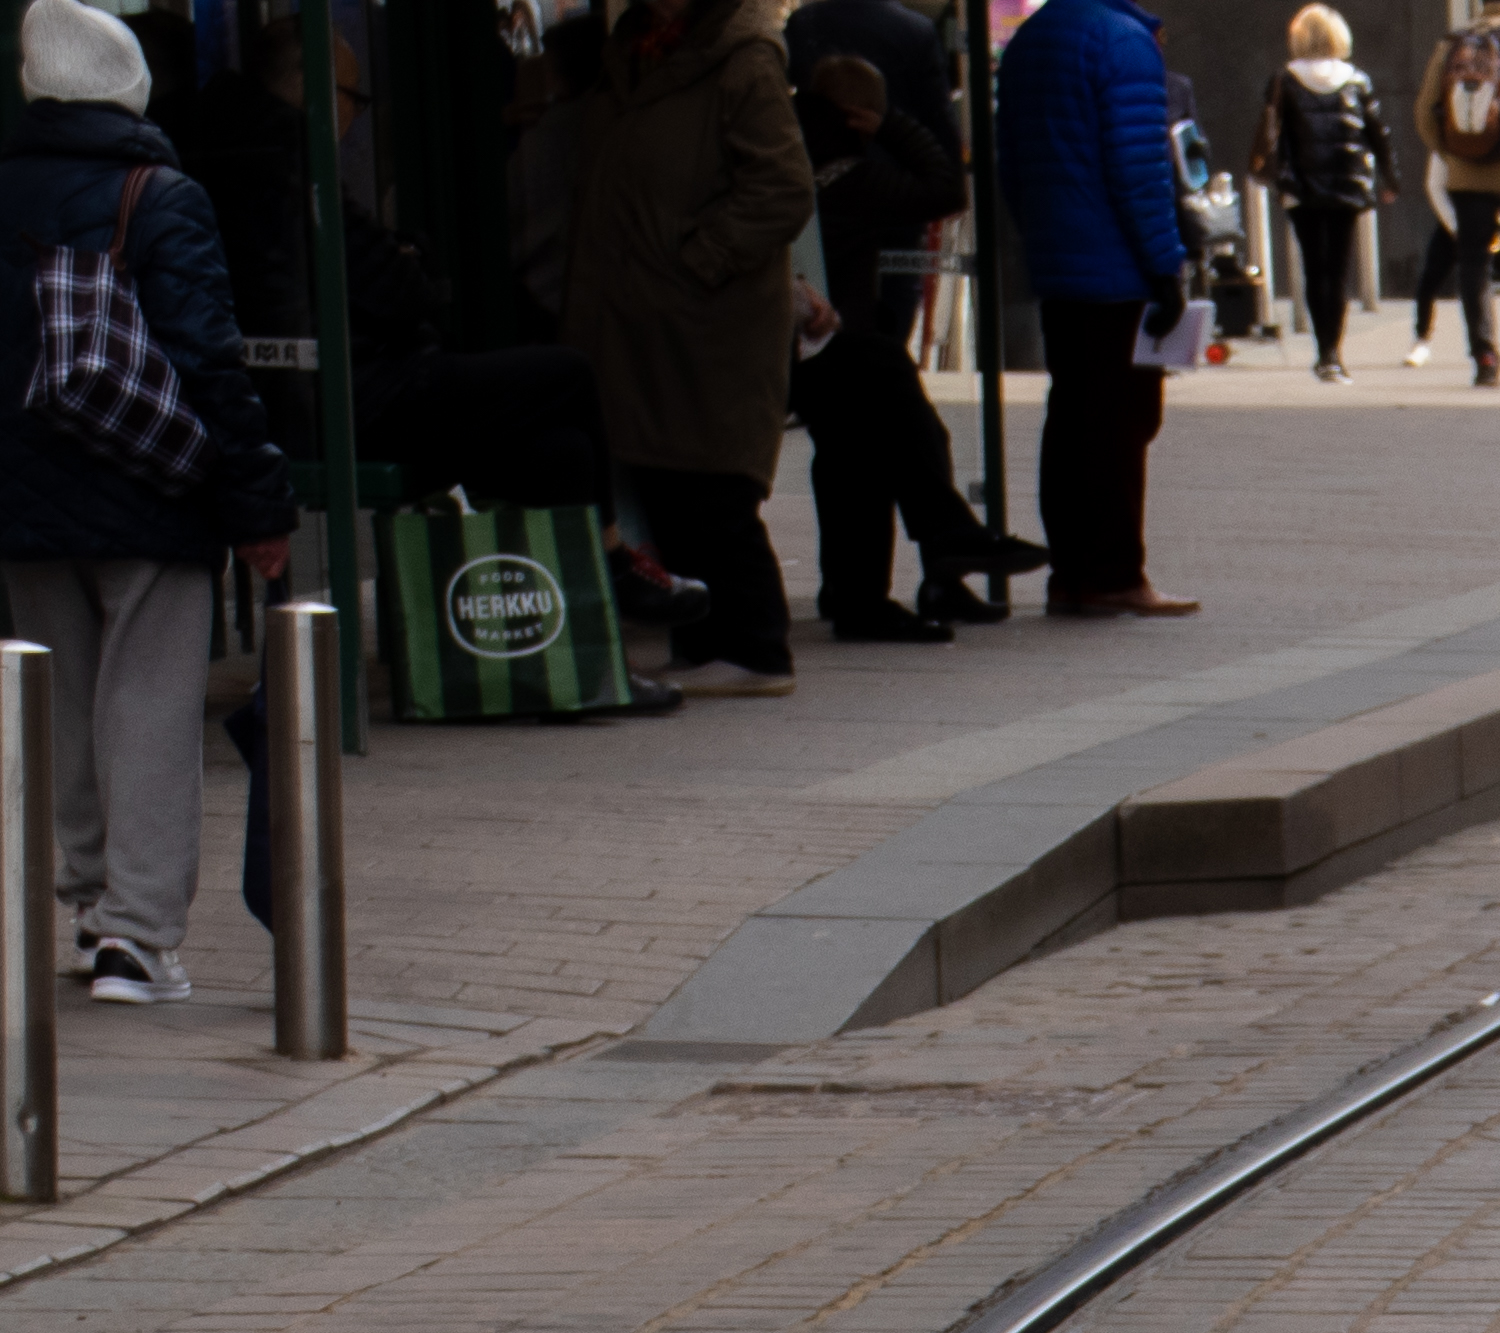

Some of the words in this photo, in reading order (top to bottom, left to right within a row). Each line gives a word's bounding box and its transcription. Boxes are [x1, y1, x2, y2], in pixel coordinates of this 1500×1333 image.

[479, 571, 525, 585] FOOD
[458, 590, 552, 620] HERKKU
[475, 622, 543, 641] MARKET
